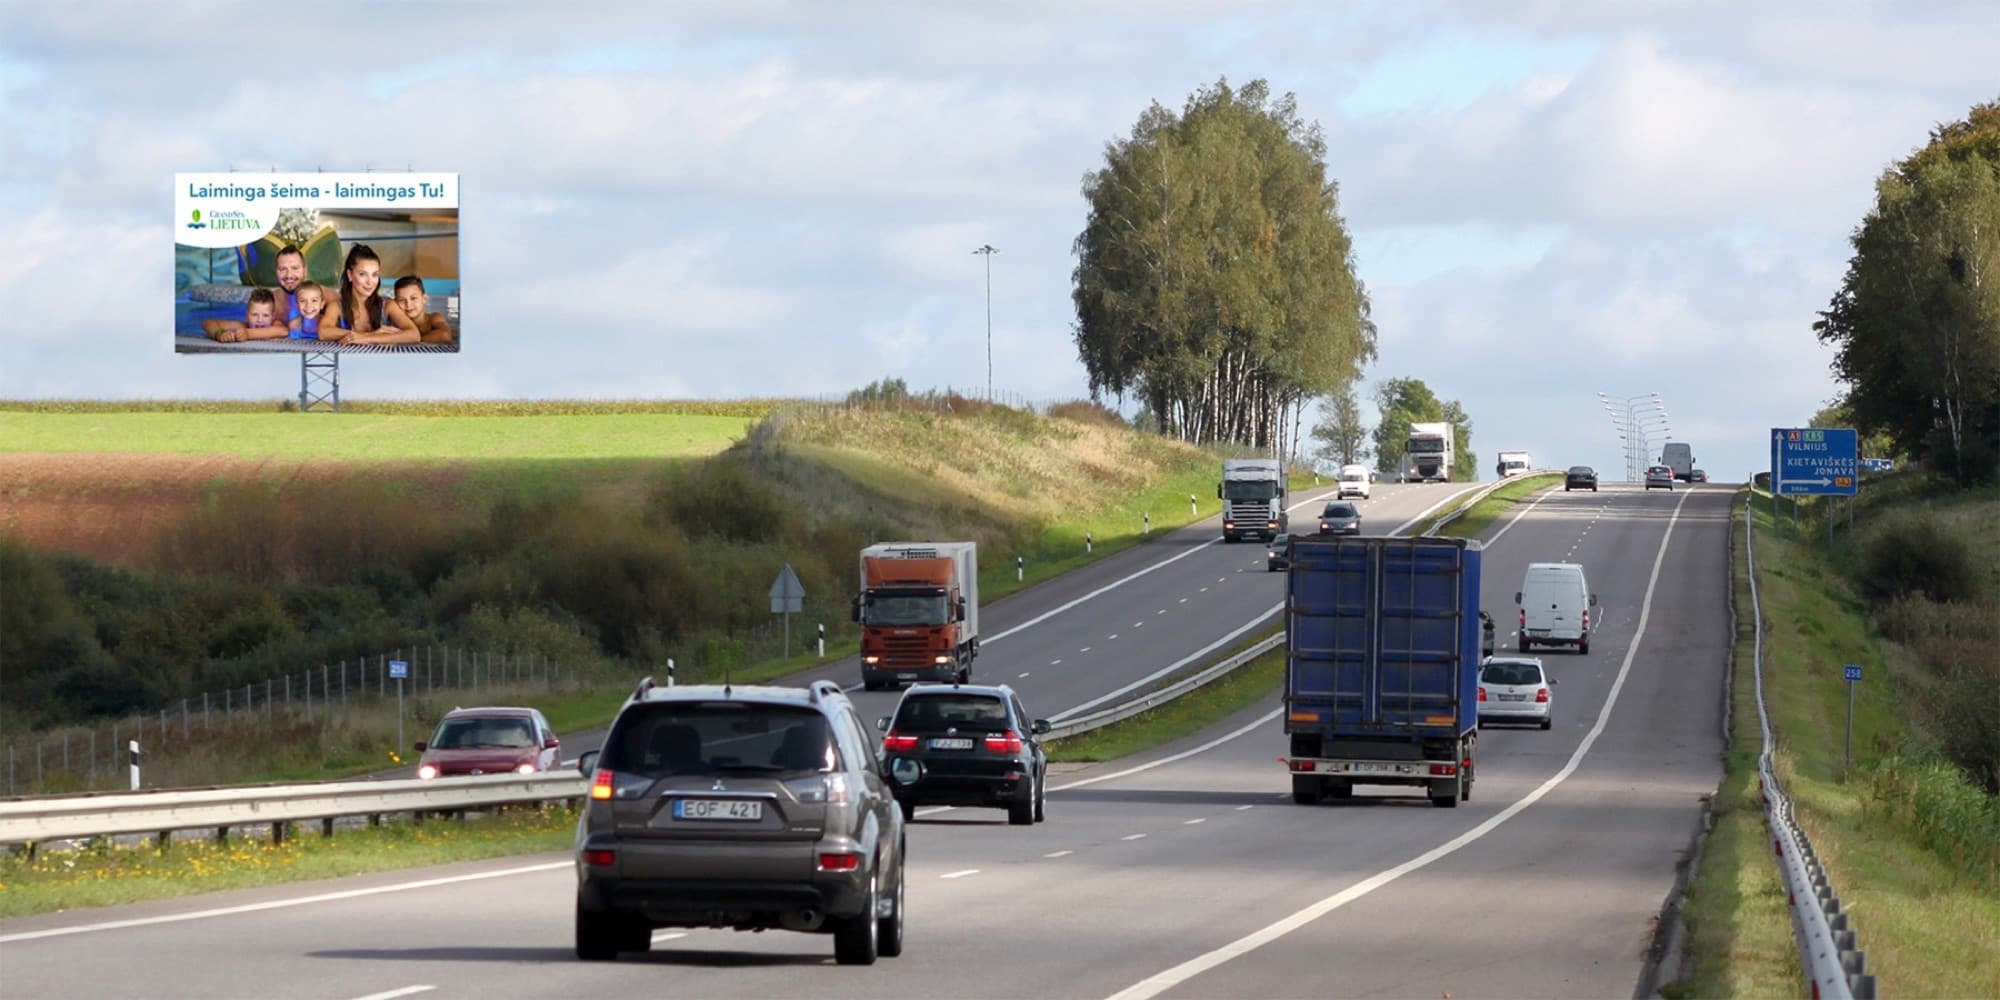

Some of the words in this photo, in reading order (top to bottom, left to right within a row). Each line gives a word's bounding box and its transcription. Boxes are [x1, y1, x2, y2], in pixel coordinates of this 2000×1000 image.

[189, 183, 266, 201] Laiminga
[270, 182, 320, 198] šeima
[335, 183, 416, 201] laimingas
[419, 183, 444, 198] Tu!
[210, 219, 260, 230] LIETUVA
[1788, 443, 1828, 451] VILNIUS
[1814, 467, 1854, 476] JONAVA
[729, 803, 758, 817] 421
